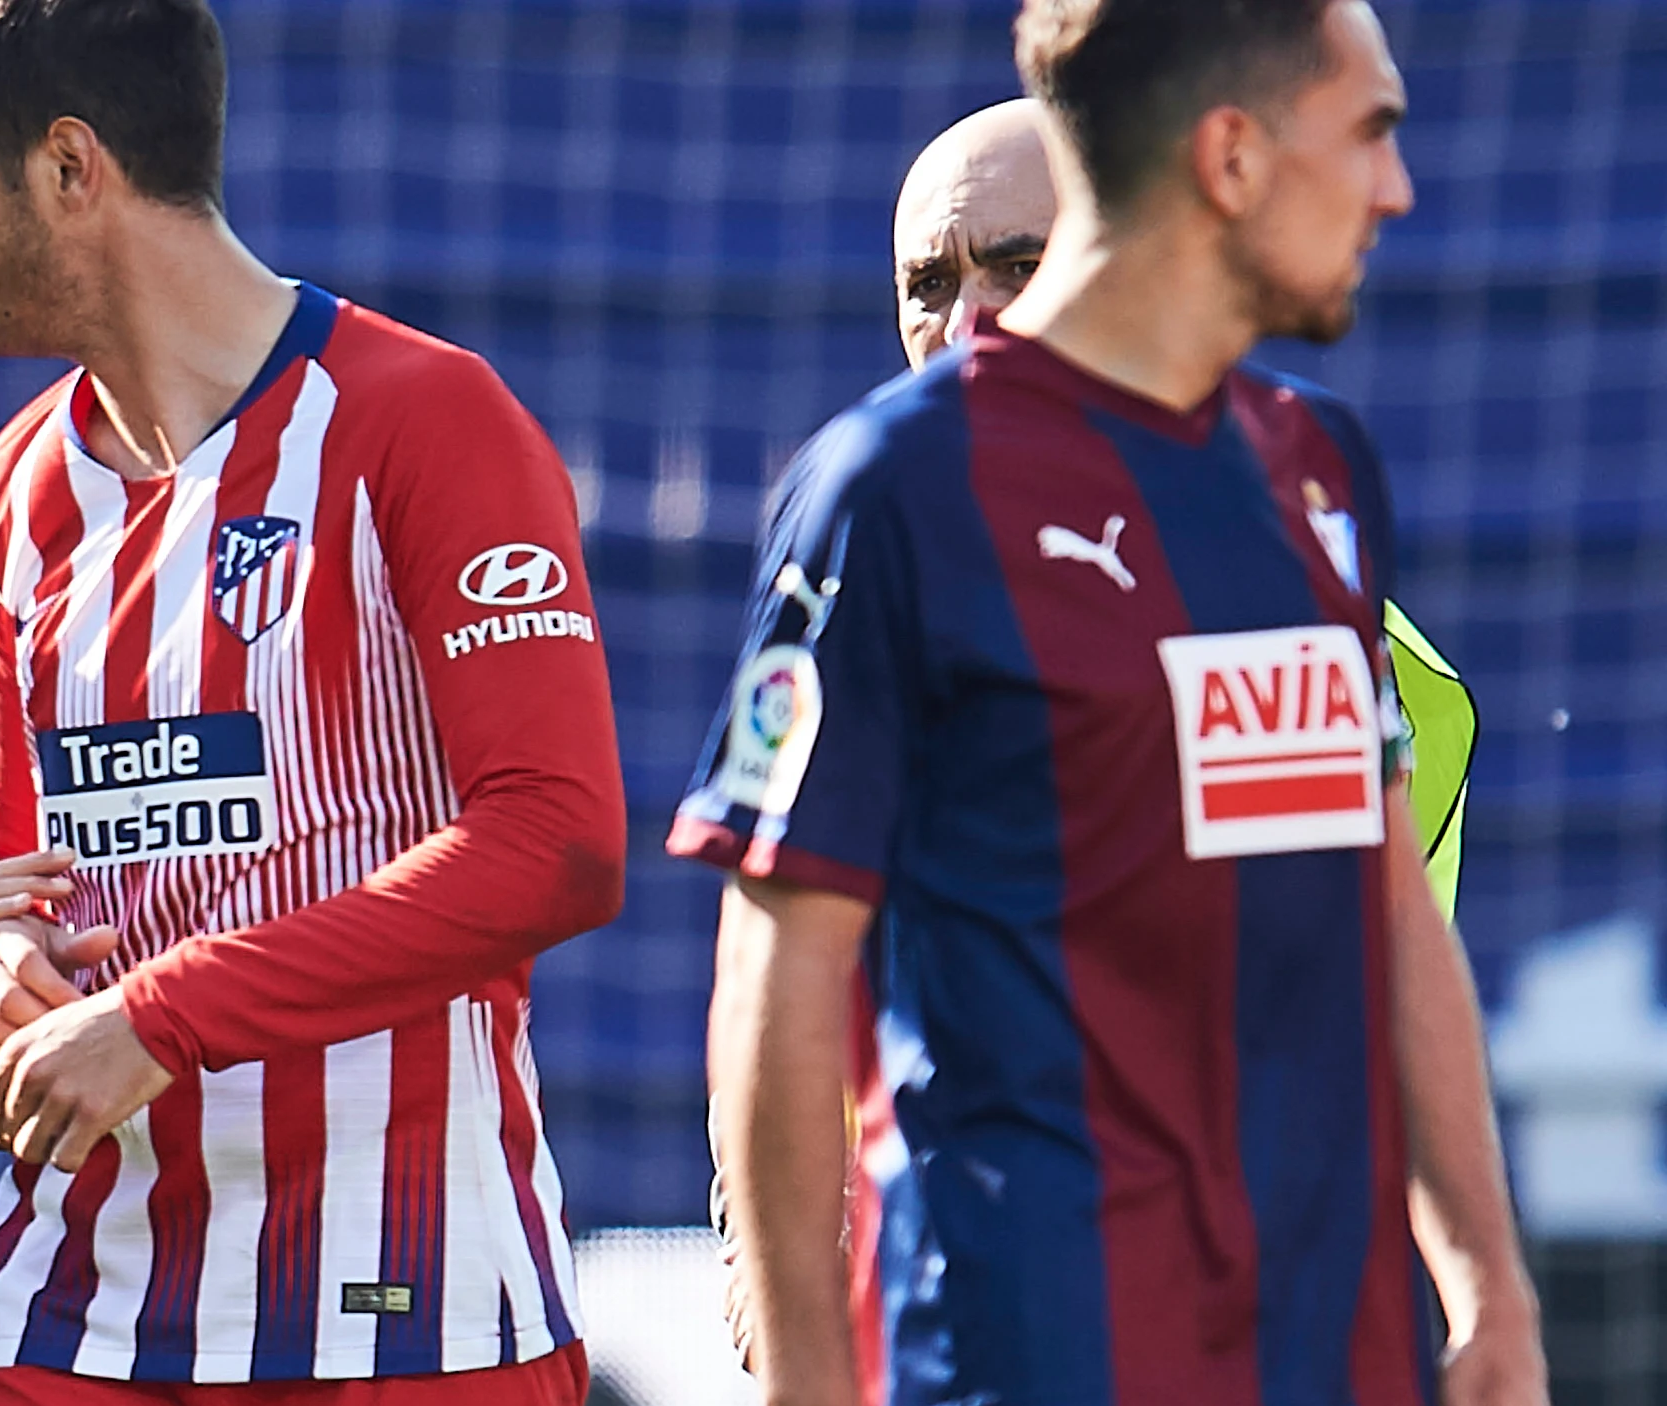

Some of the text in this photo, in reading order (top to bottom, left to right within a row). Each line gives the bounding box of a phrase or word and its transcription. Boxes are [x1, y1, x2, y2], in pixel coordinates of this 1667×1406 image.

[442, 610, 595, 659] HYUNDAI
[60, 722, 201, 787] Trade
[47, 797, 263, 859] Plus500
